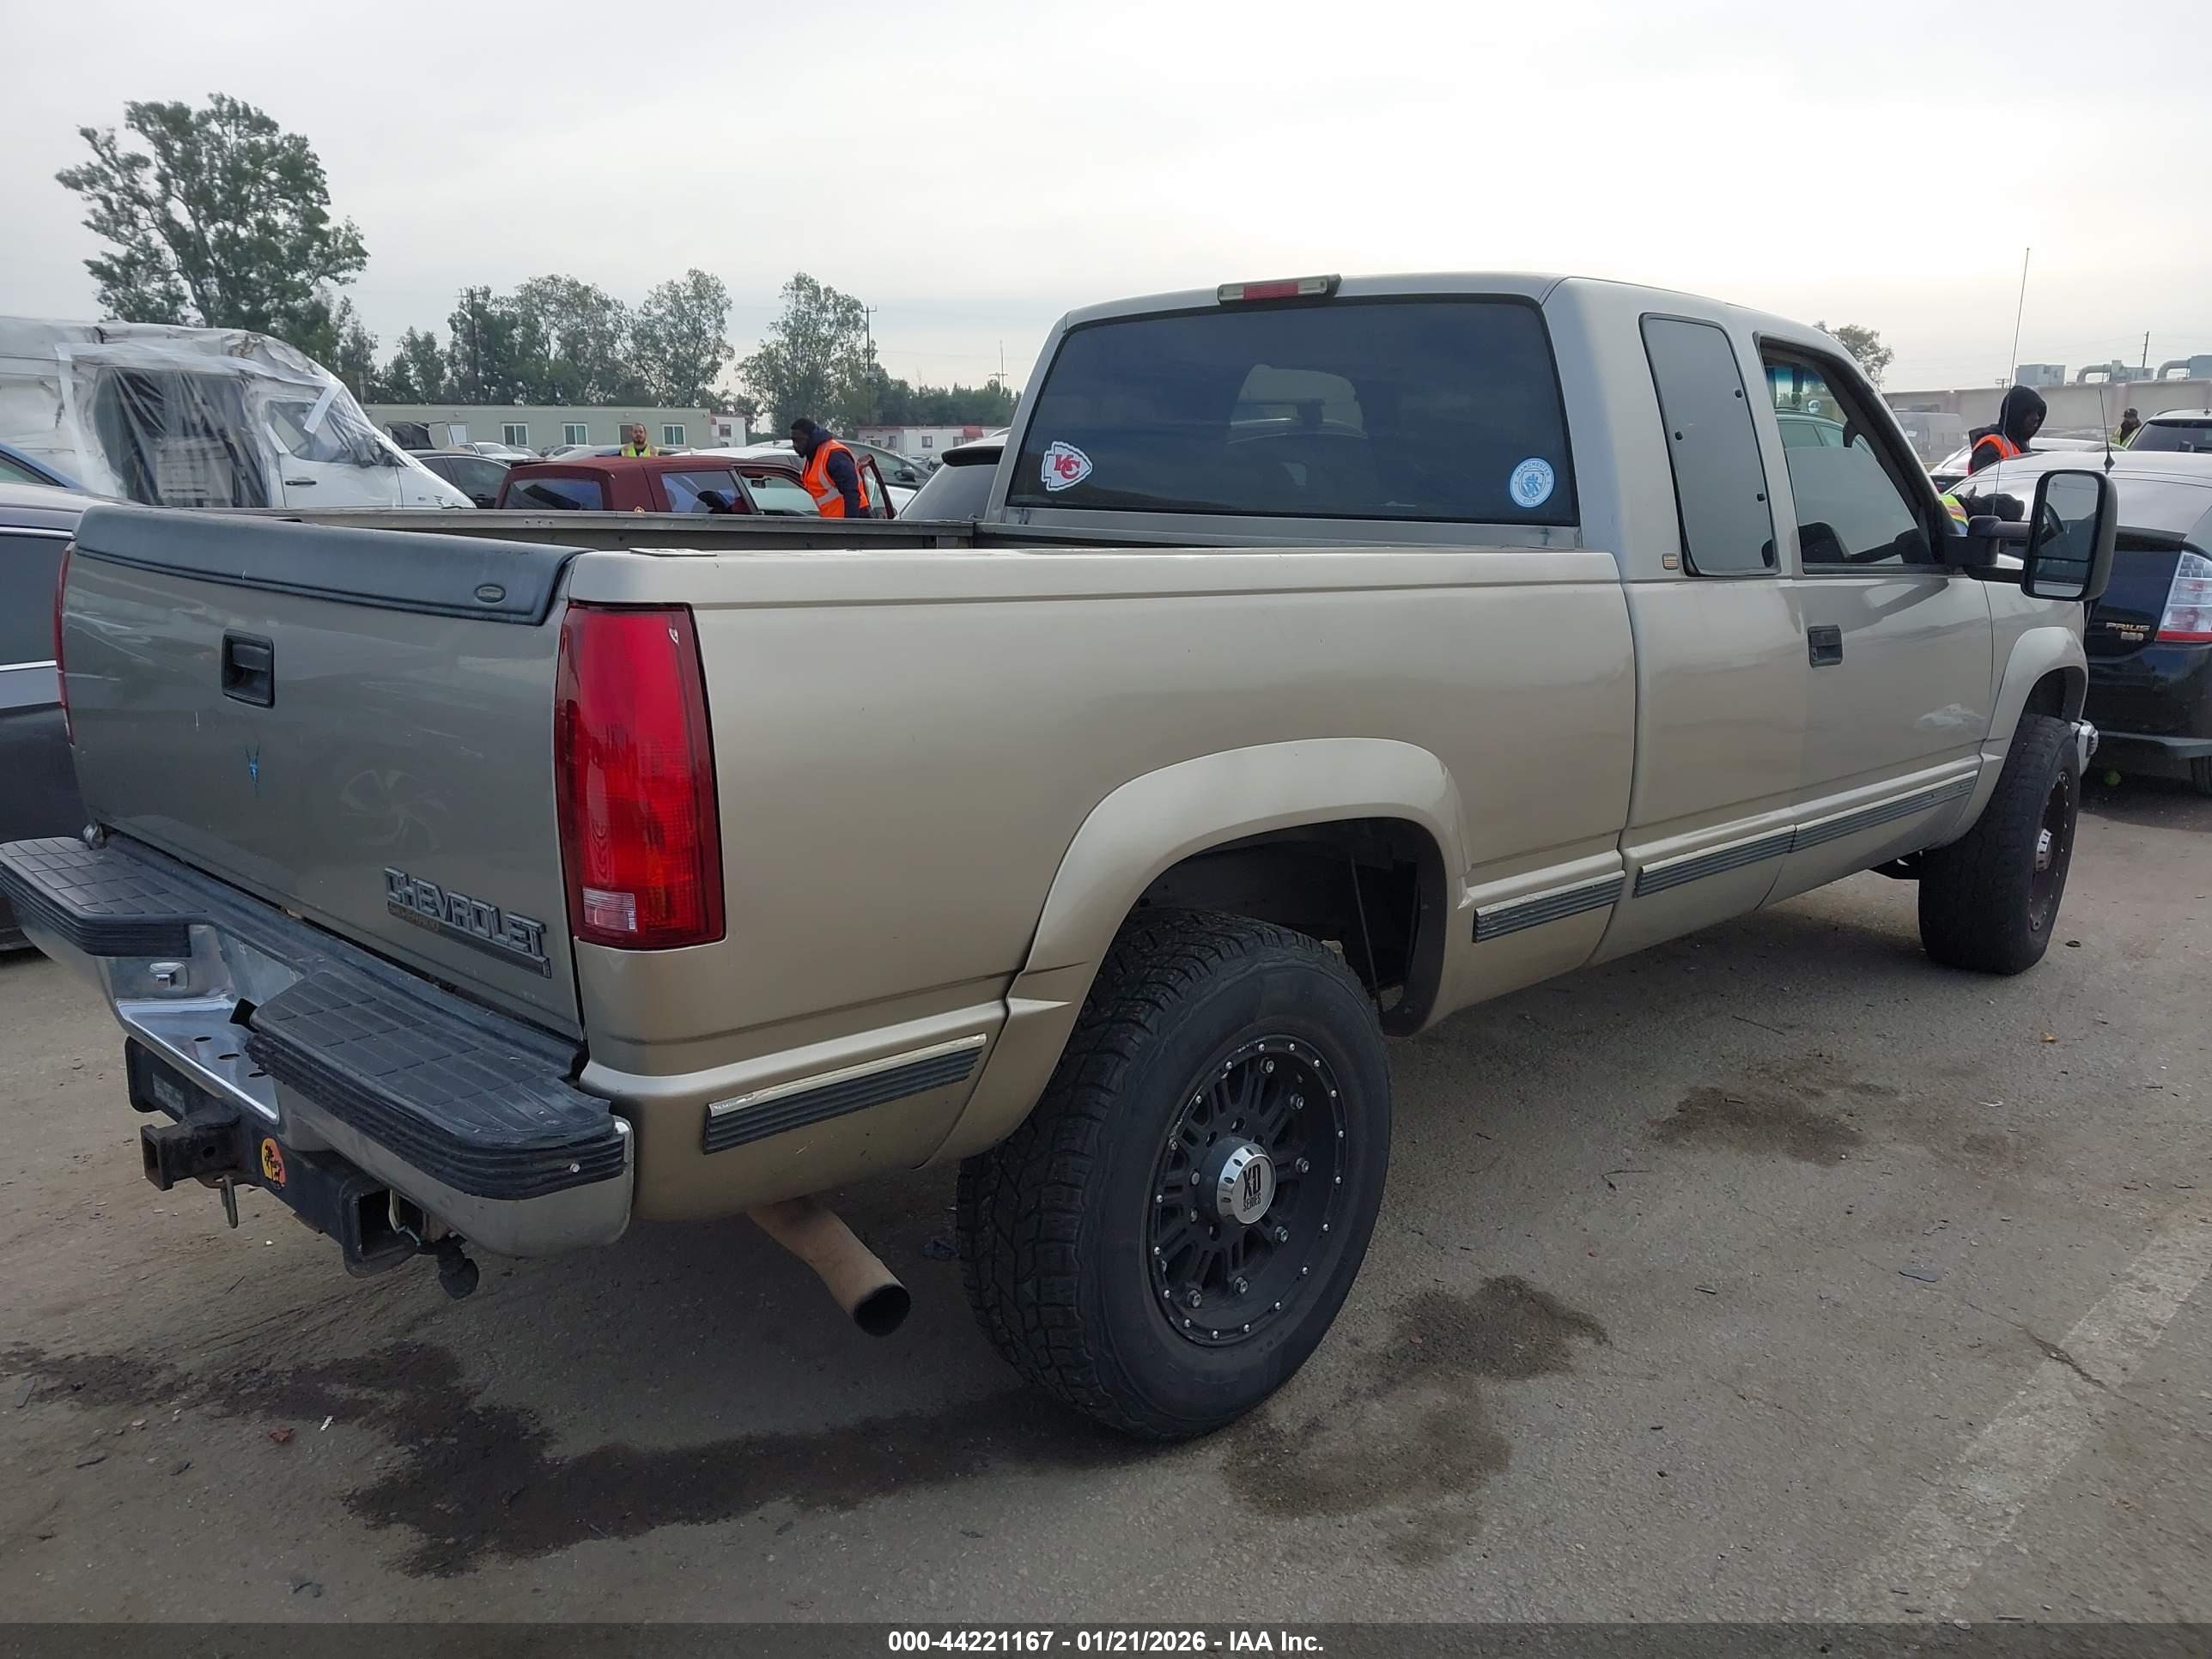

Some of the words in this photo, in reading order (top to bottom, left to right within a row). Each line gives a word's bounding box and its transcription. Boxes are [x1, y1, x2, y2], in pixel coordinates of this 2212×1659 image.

[1054, 454, 1081, 479] KC
[2106, 622, 2151, 632] PRIUS
[384, 866, 547, 958] CHEVROLET
[1243, 1164, 1261, 1200] XD
[1243, 1193, 1261, 1212] SERIES
